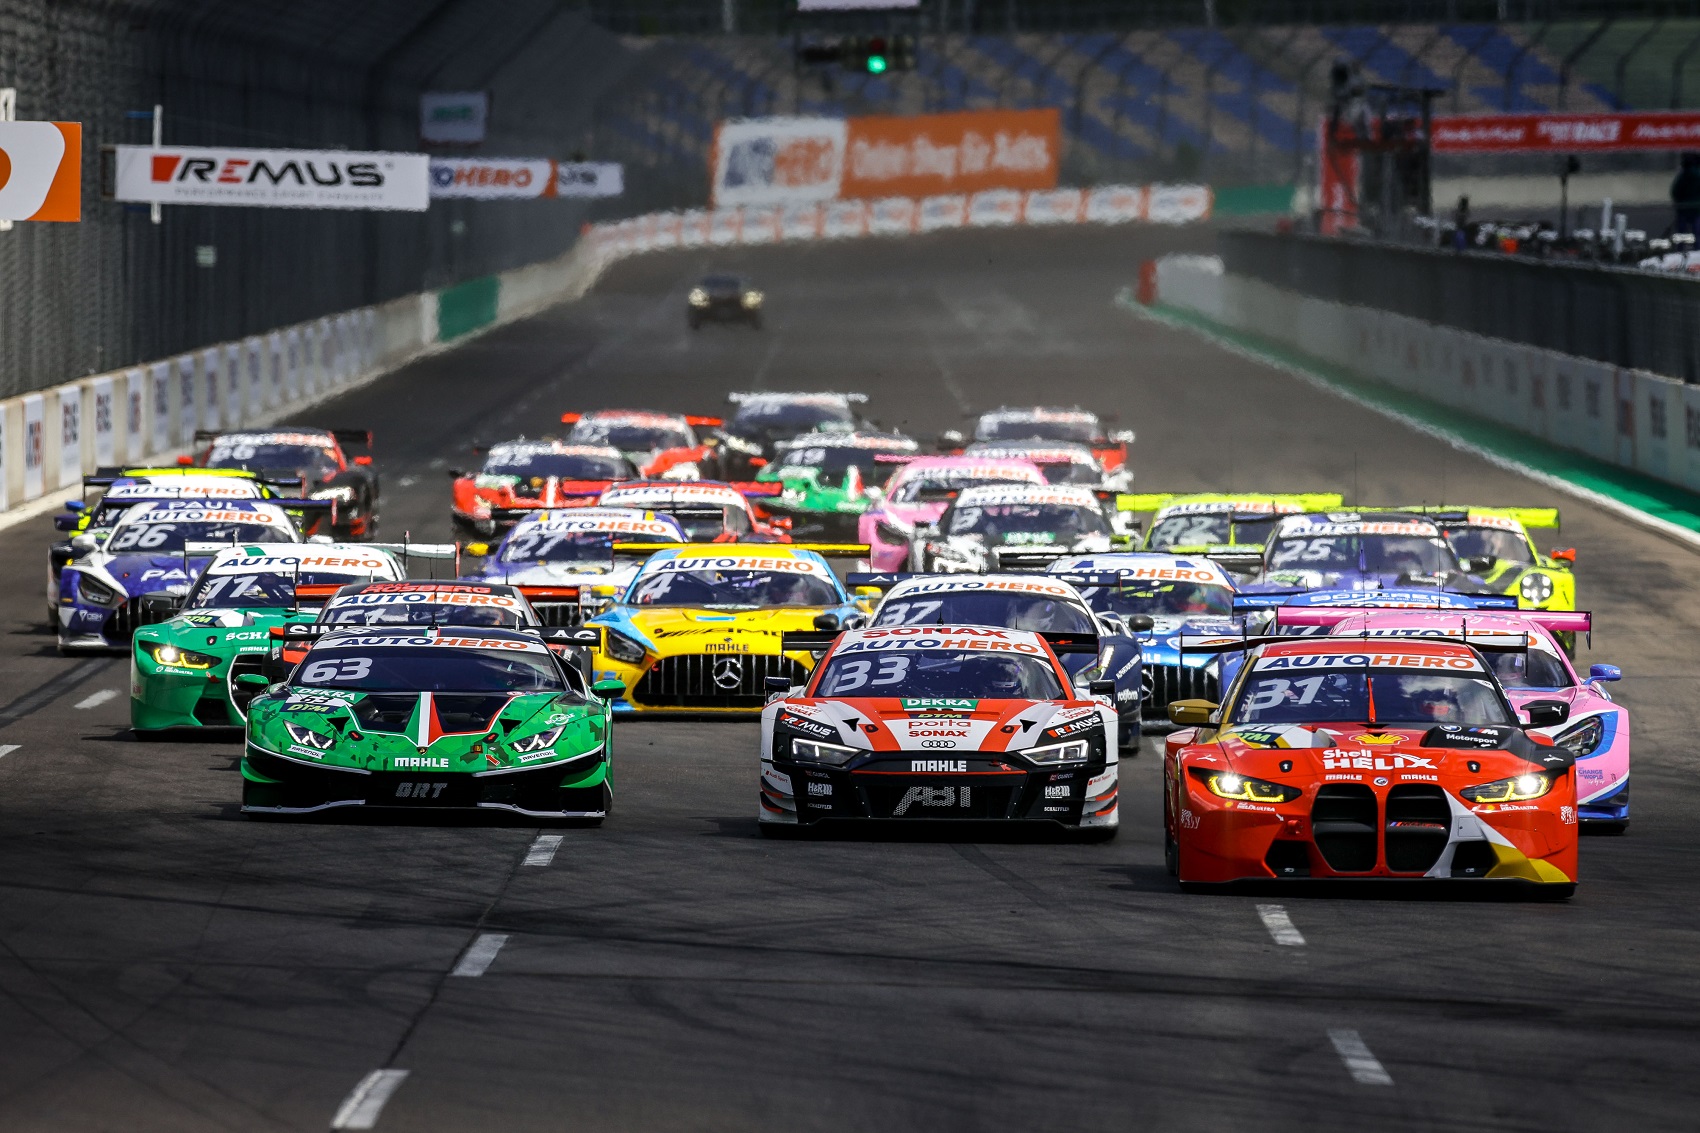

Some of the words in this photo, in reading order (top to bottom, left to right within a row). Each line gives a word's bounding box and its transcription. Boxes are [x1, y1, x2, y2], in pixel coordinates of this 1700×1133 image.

[177, 157, 385, 188] REMUS
[120, 486, 248, 496] AUTOHERO
[168, 501, 240, 511] PAUL
[139, 511, 273, 523] AUTOHERO
[529, 521, 667, 533] AUTOHERO
[112, 523, 178, 549] 36
[512, 532, 568, 561] 27
[1273, 538, 1337, 564] 25
[219, 556, 383, 569] AUTOHERO
[661, 558, 814, 571] AUTOHERO
[204, 575, 259, 600] 11
[361, 584, 491, 594] ROSBERG
[648, 572, 679, 598] 4
[900, 581, 1067, 597] AUTOHERO
[339, 593, 515, 608] AUTOHERO
[882, 600, 943, 625] 37
[861, 626, 1010, 640] SONAX
[336, 637, 528, 650] AUTOHERO
[705, 643, 750, 653] MAHLE
[842, 638, 1040, 654] AUTOHERO
[1262, 654, 1475, 670] AUTOHERO
[301, 657, 373, 683] 63
[834, 655, 912, 693] 33
[298, 687, 356, 701] DEKRA
[1247, 675, 1324, 710] 31
[287, 703, 330, 713] DTM
[906, 699, 972, 707] DEKRA
[784, 716, 832, 738] REMUS
[908, 719, 972, 730] porta
[1055, 714, 1101, 736] REMUS
[909, 730, 969, 738] SONAX
[1446, 733, 1498, 745] Motorsport
[1322, 748, 1372, 759] Shell
[394, 757, 450, 768] MAHLE
[911, 760, 967, 772] MAHLE
[1322, 755, 1439, 770] HELIX
